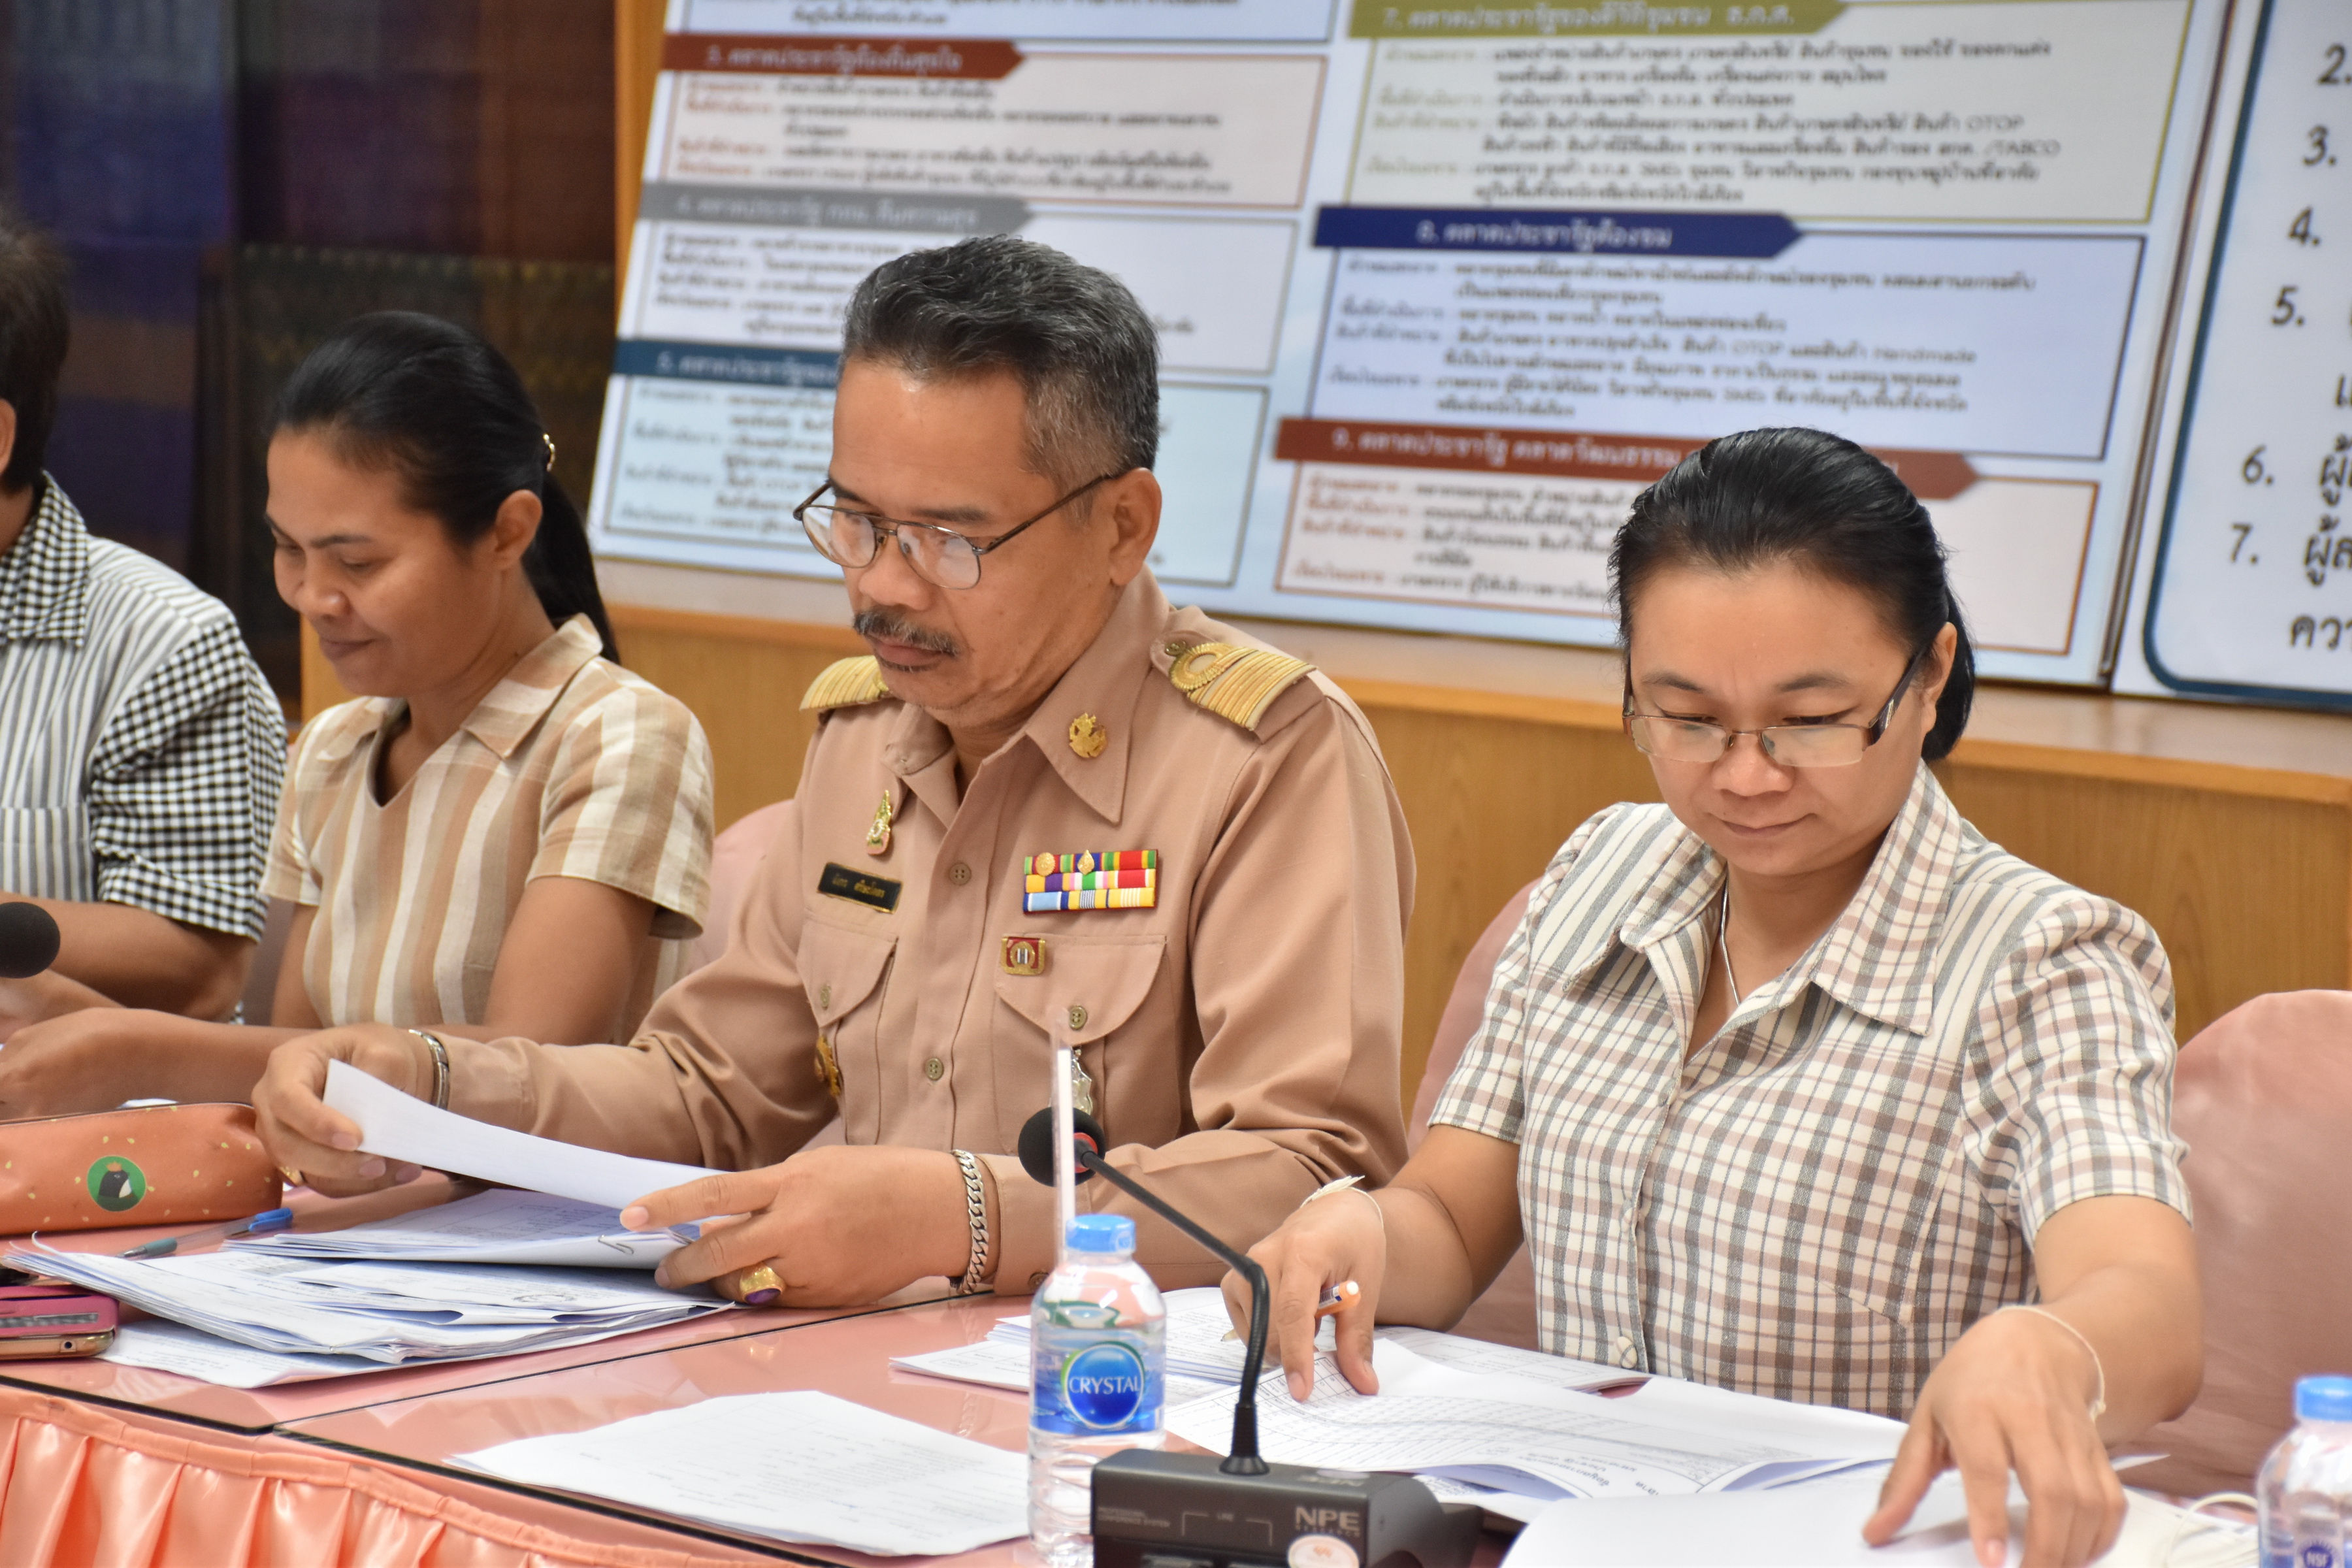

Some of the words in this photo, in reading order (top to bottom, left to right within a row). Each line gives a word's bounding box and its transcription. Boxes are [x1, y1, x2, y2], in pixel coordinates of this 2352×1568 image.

[2317, 44, 2352, 85] 2.
[2303, 125, 2337, 167] 3.
[2288, 206, 2322, 248] 4.
[2270, 286, 2306, 327] 5.
[2241, 444, 2274, 485] 6.
[2230, 523, 2259, 566] 7.
[1069, 1375, 1141, 1395] CRYSTAL
[1295, 1506, 1360, 1532] NPE
